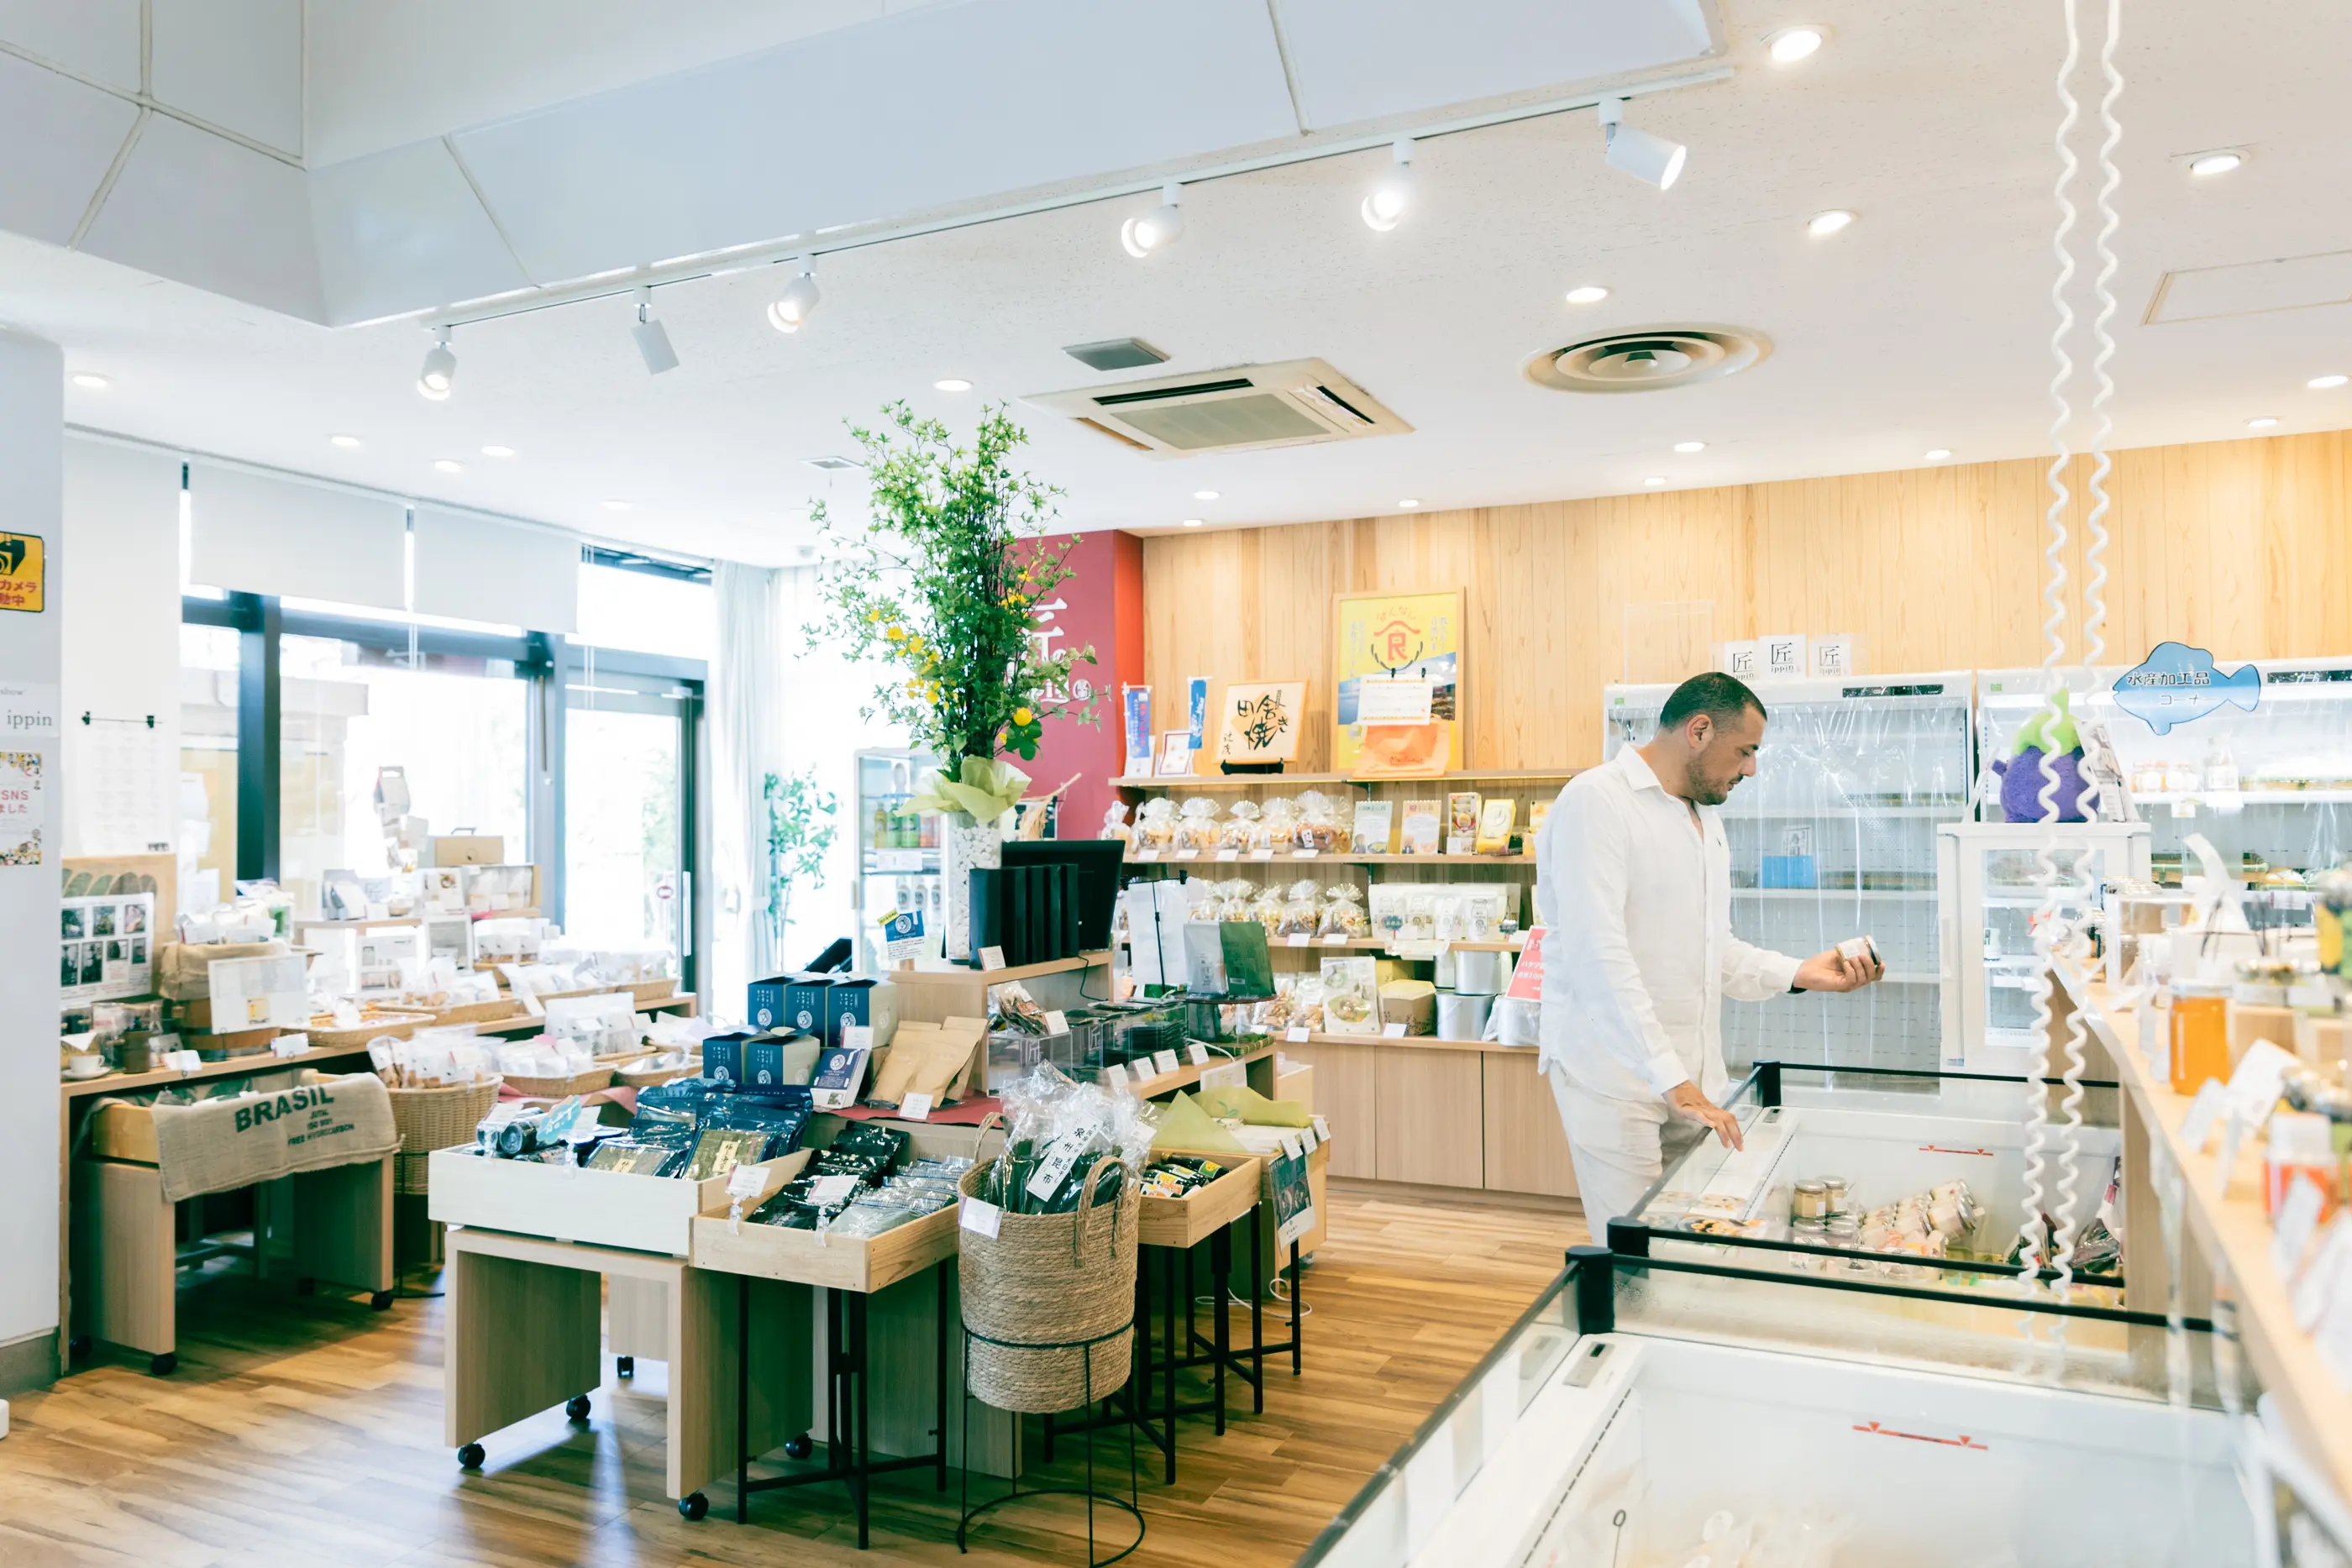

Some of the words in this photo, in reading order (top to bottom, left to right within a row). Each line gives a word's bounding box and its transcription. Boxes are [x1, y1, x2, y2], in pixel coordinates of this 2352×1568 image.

[0, 579, 37, 593] カメラ
[2127, 672, 2211, 687] 水産加工品
[2160, 694, 2218, 706] コーナー
[7, 710, 52, 730] ippin
[1, 790, 29, 800] SNS
[234, 1085, 334, 1133] BRASIL
[1042, 1127, 1085, 1185] 泉州昆布
